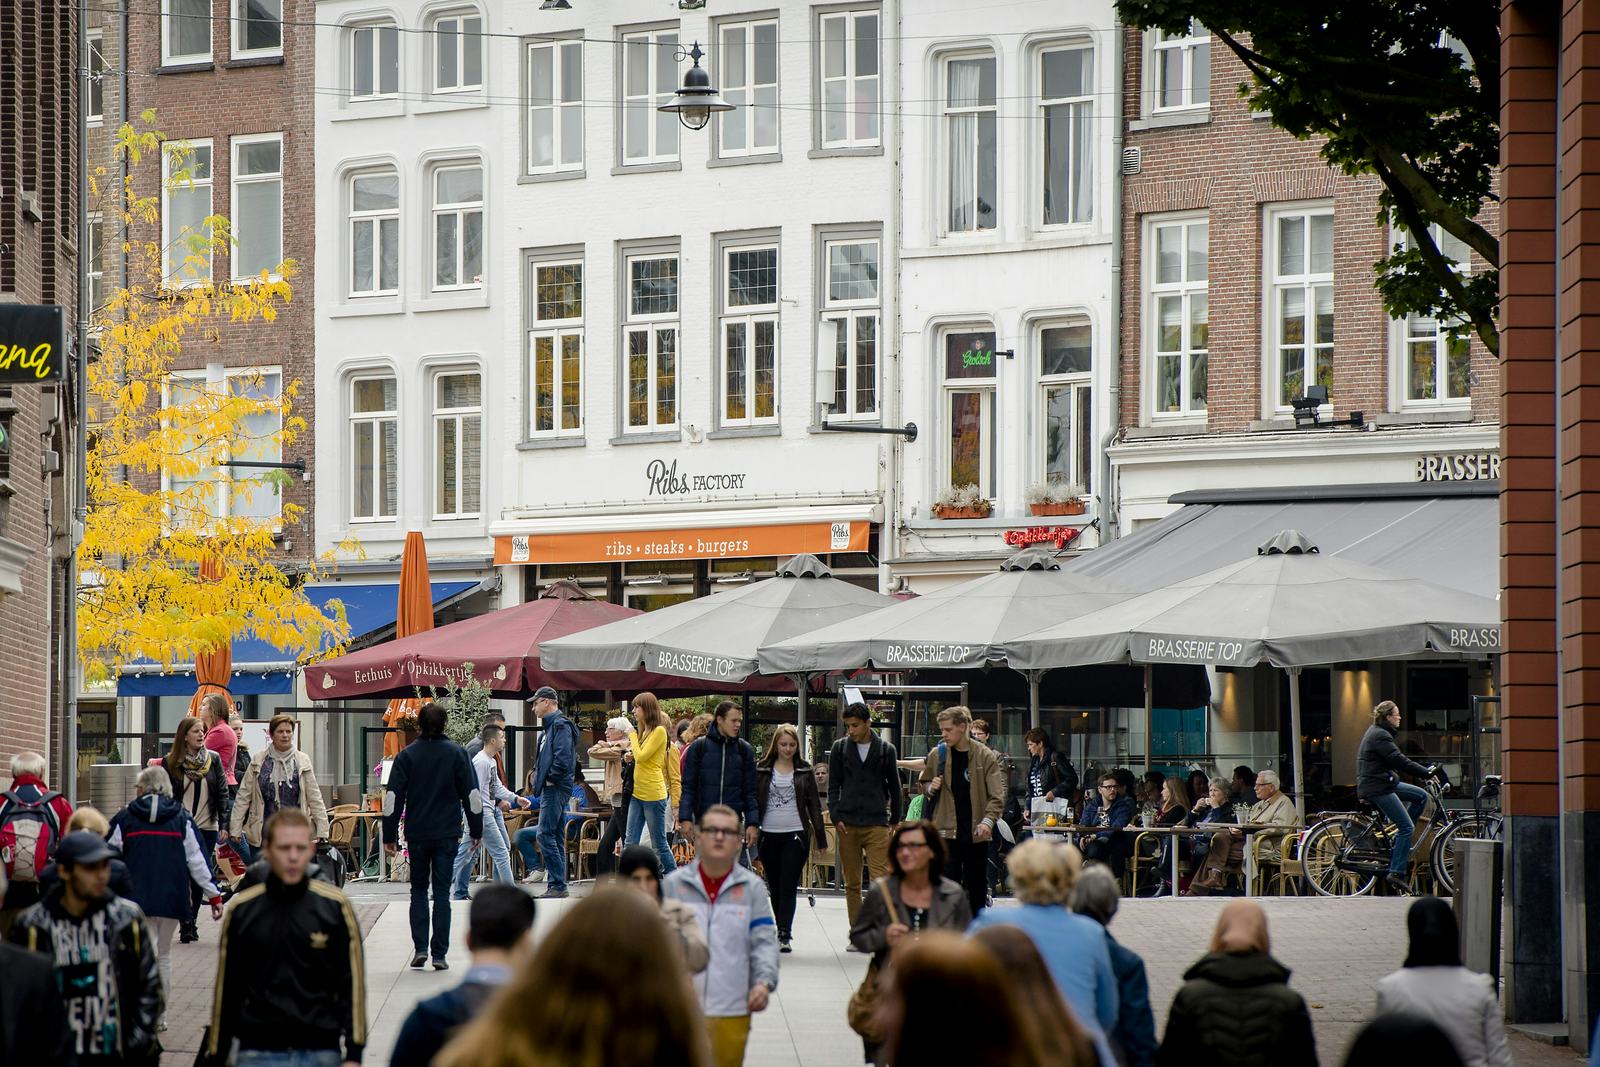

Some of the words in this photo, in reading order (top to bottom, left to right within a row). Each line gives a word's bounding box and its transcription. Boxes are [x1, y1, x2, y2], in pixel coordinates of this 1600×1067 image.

[646, 459, 690, 495] Ribs
[693, 473, 746, 490] FACTORY
[1415, 454, 1500, 481] BRASSER
[832, 524, 849, 538] Ribs
[605, 541, 632, 556] ribs
[644, 540, 685, 555] steaks
[697, 539, 749, 556] burgers
[1450, 629, 1501, 648] BRASS
[886, 645, 945, 663] BRASSERIE
[947, 645, 970, 663] TOP
[1148, 639, 1215, 660] BRASSERIE
[1217, 642, 1242, 661] TOP
[354, 665, 393, 684] Eethuis
[407, 660, 471, 682] Opkikkertje
[658, 651, 712, 675] BRASSERIE
[715, 658, 735, 677] TOP
